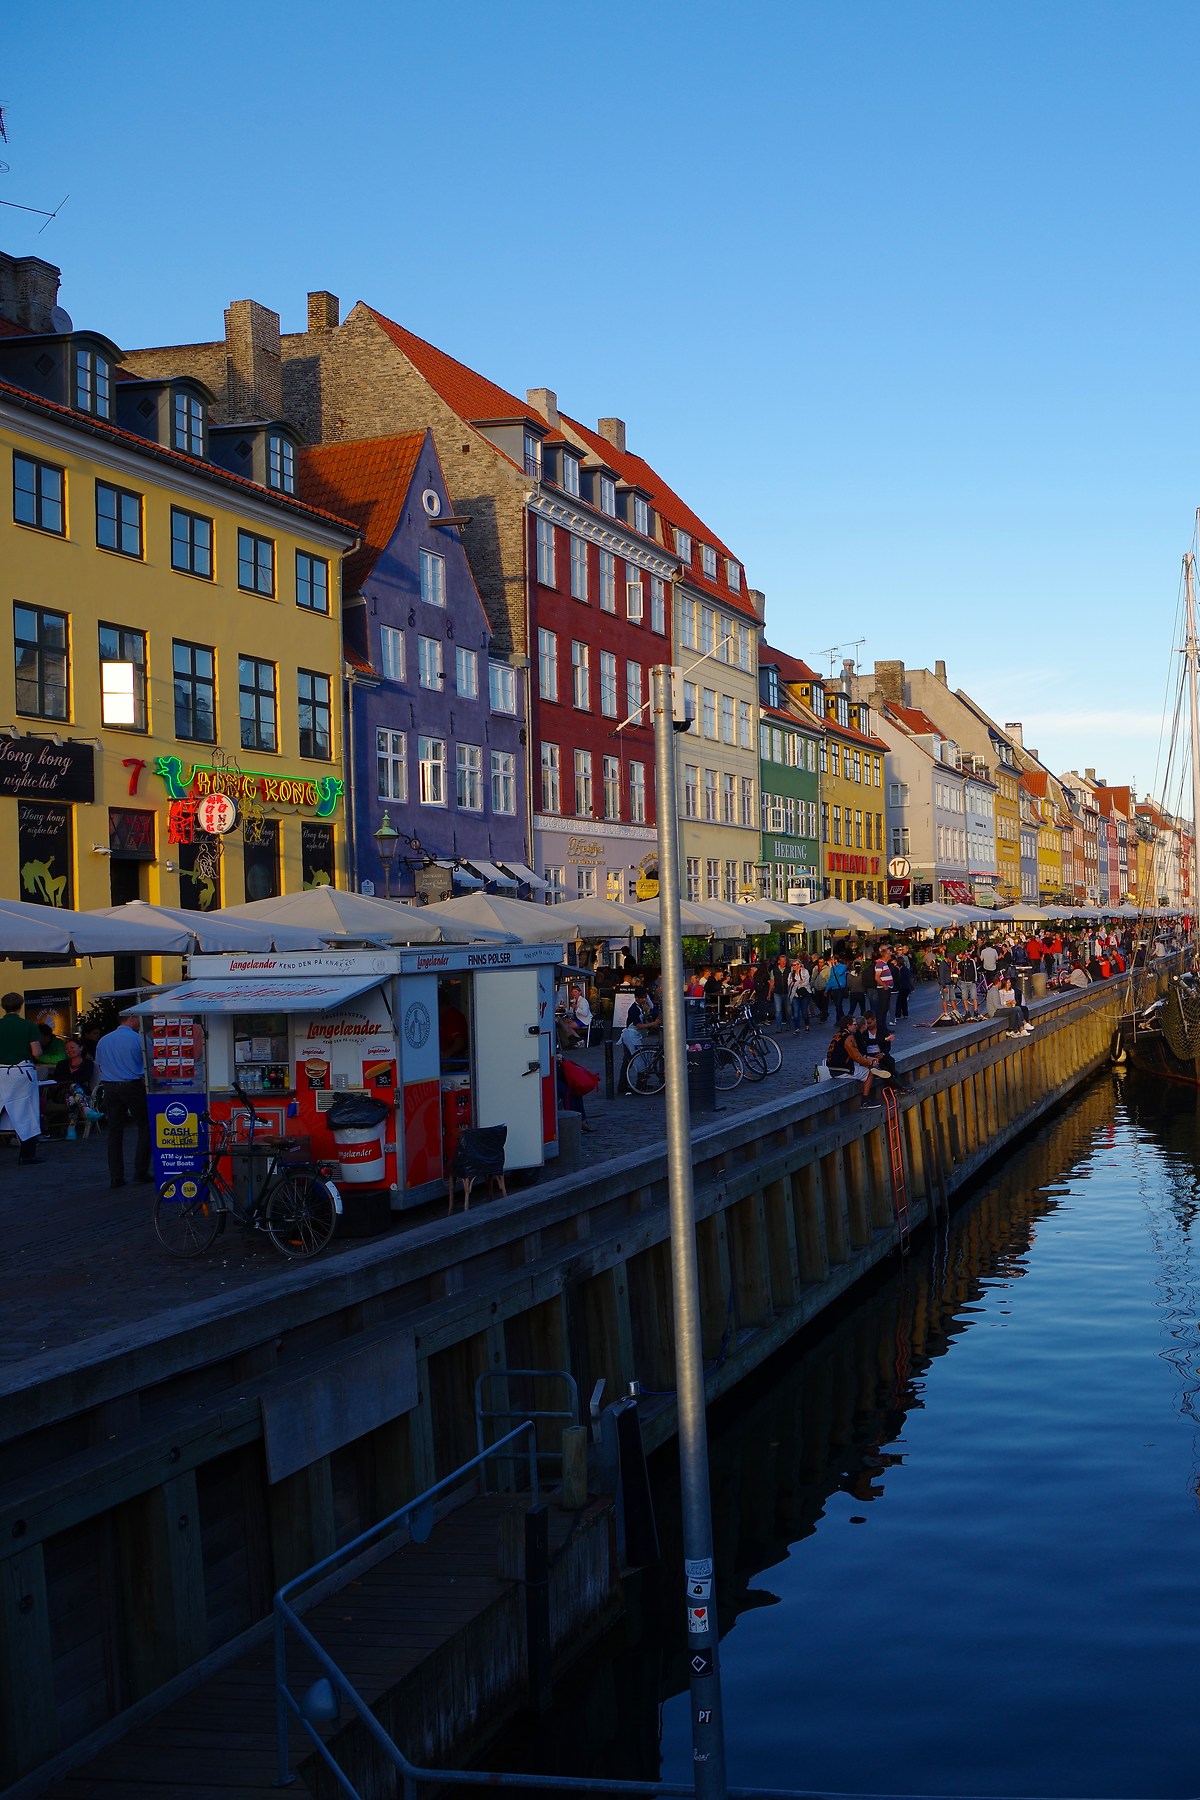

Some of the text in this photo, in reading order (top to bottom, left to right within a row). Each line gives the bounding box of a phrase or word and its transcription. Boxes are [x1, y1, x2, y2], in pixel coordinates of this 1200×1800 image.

[38, 745, 74, 776] kong
[3, 771, 59, 793] nightclub
[194, 771, 319, 806] HONG KONG
[20, 806, 66, 827] Hong kong
[774, 841, 807, 860] HEERING
[890, 860, 906, 877] 17
[229, 959, 277, 972] Langelænder
[468, 954, 487, 966] FINNS
[488, 952, 511, 965] PØLSER
[306, 1020, 382, 1040] Langelænder
[163, 1127, 190, 1138] CASH
[698, 1710, 711, 1724] PT
